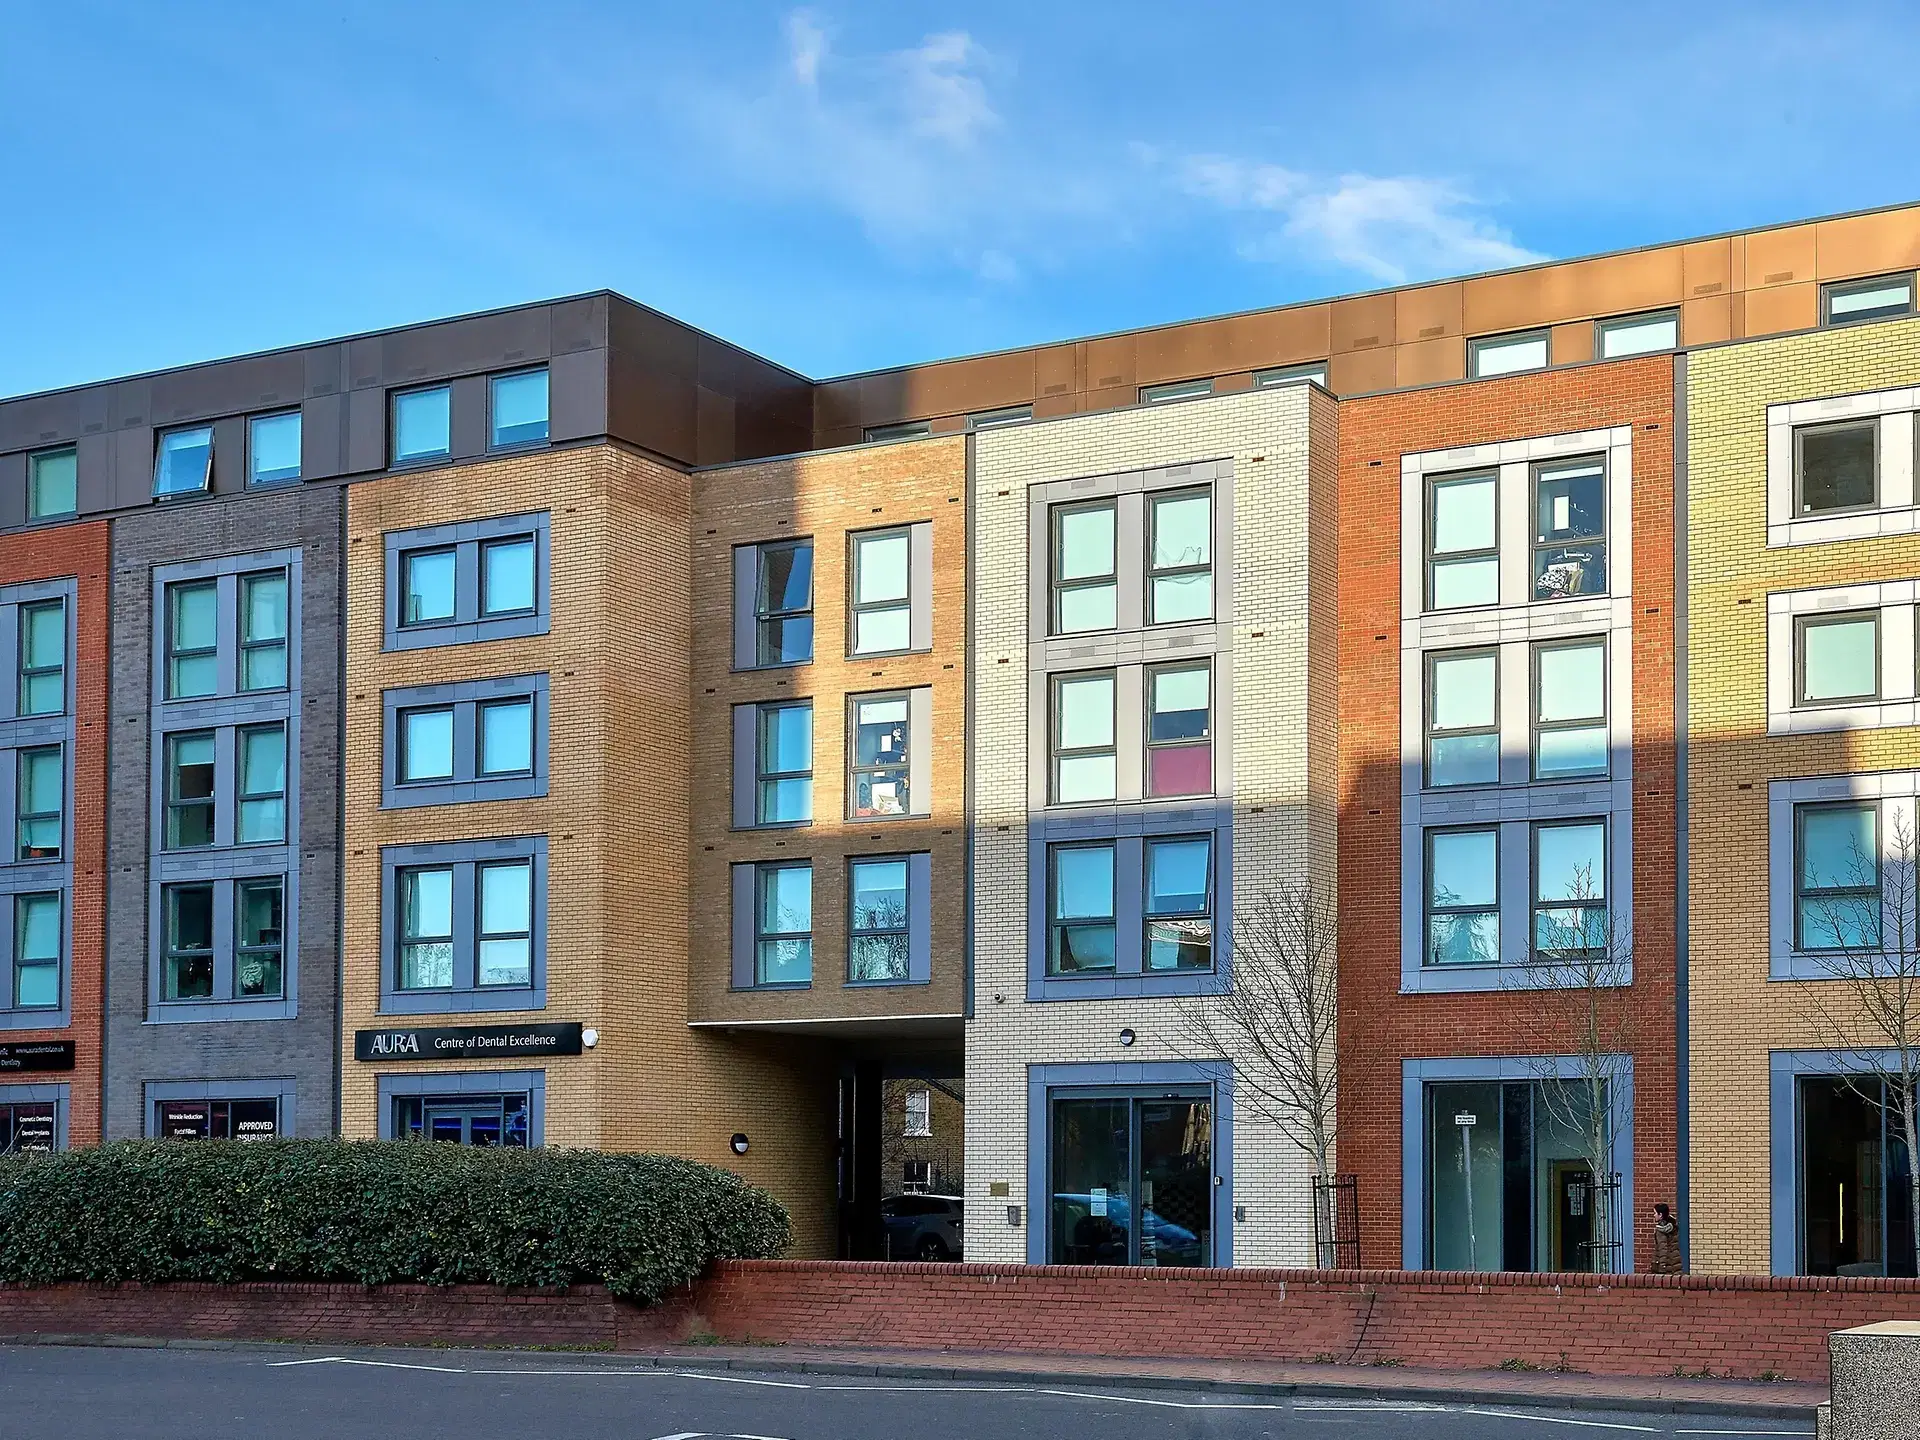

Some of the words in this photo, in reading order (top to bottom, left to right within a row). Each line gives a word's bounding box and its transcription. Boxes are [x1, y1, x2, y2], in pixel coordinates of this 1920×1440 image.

[371, 1034, 419, 1053] AURA
[434, 1037, 464, 1049] Centre
[466, 1036, 476, 1048] of
[478, 1035, 507, 1047] Dental
[509, 1034, 556, 1046] Excellence
[238, 1121, 273, 1130] APPROVED
